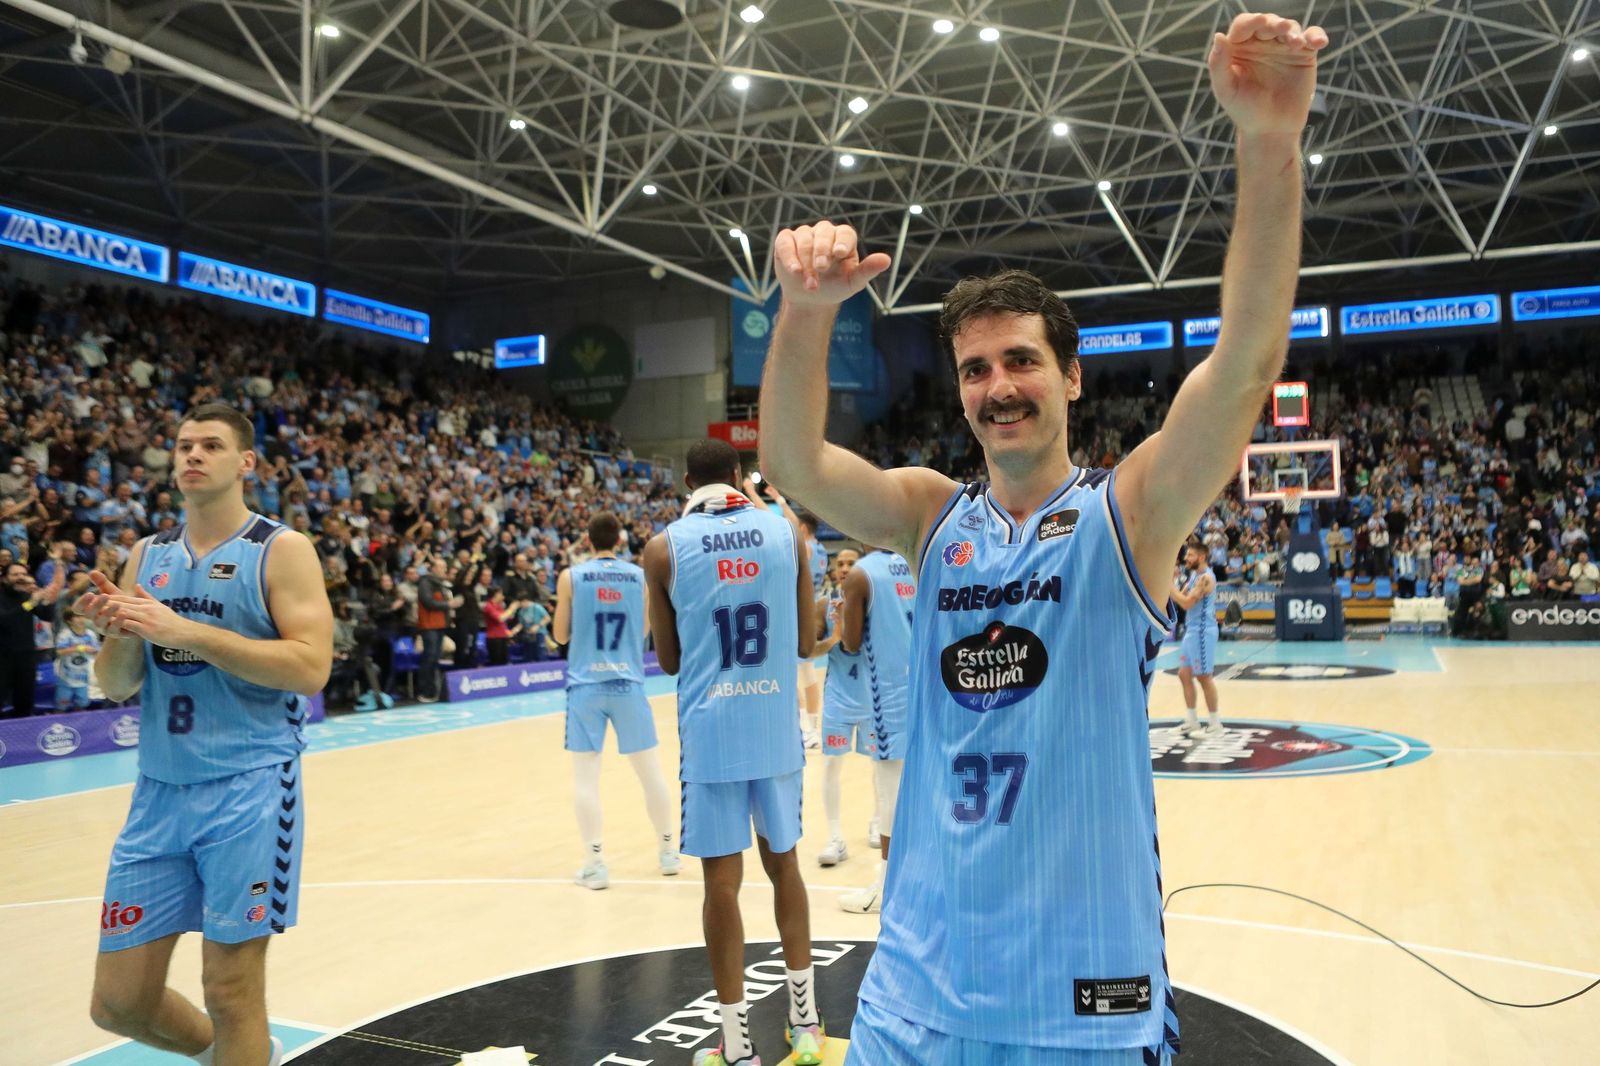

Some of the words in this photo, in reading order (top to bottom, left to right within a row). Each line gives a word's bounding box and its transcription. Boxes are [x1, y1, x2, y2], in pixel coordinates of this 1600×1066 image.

[1186, 320, 1220, 335] GRUP
[1351, 308, 1410, 329] Estrella
[1413, 301, 1471, 324] Galicia
[1082, 332, 1142, 350] CANDELAS
[1041, 521, 1057, 532] liga
[702, 528, 764, 554] SAKHO
[938, 572, 1062, 611] BREOGÁN
[161, 594, 225, 620] EOGÁN
[1288, 598, 1327, 620] Río
[595, 613, 627, 651] 17
[712, 600, 769, 672] 18
[162, 647, 206, 662] Galic
[955, 642, 1029, 667] Estrella
[848, 664, 859, 681] 4
[958, 664, 1024, 689] Galicia
[168, 694, 195, 735] 8
[951, 752, 1029, 826] 37
